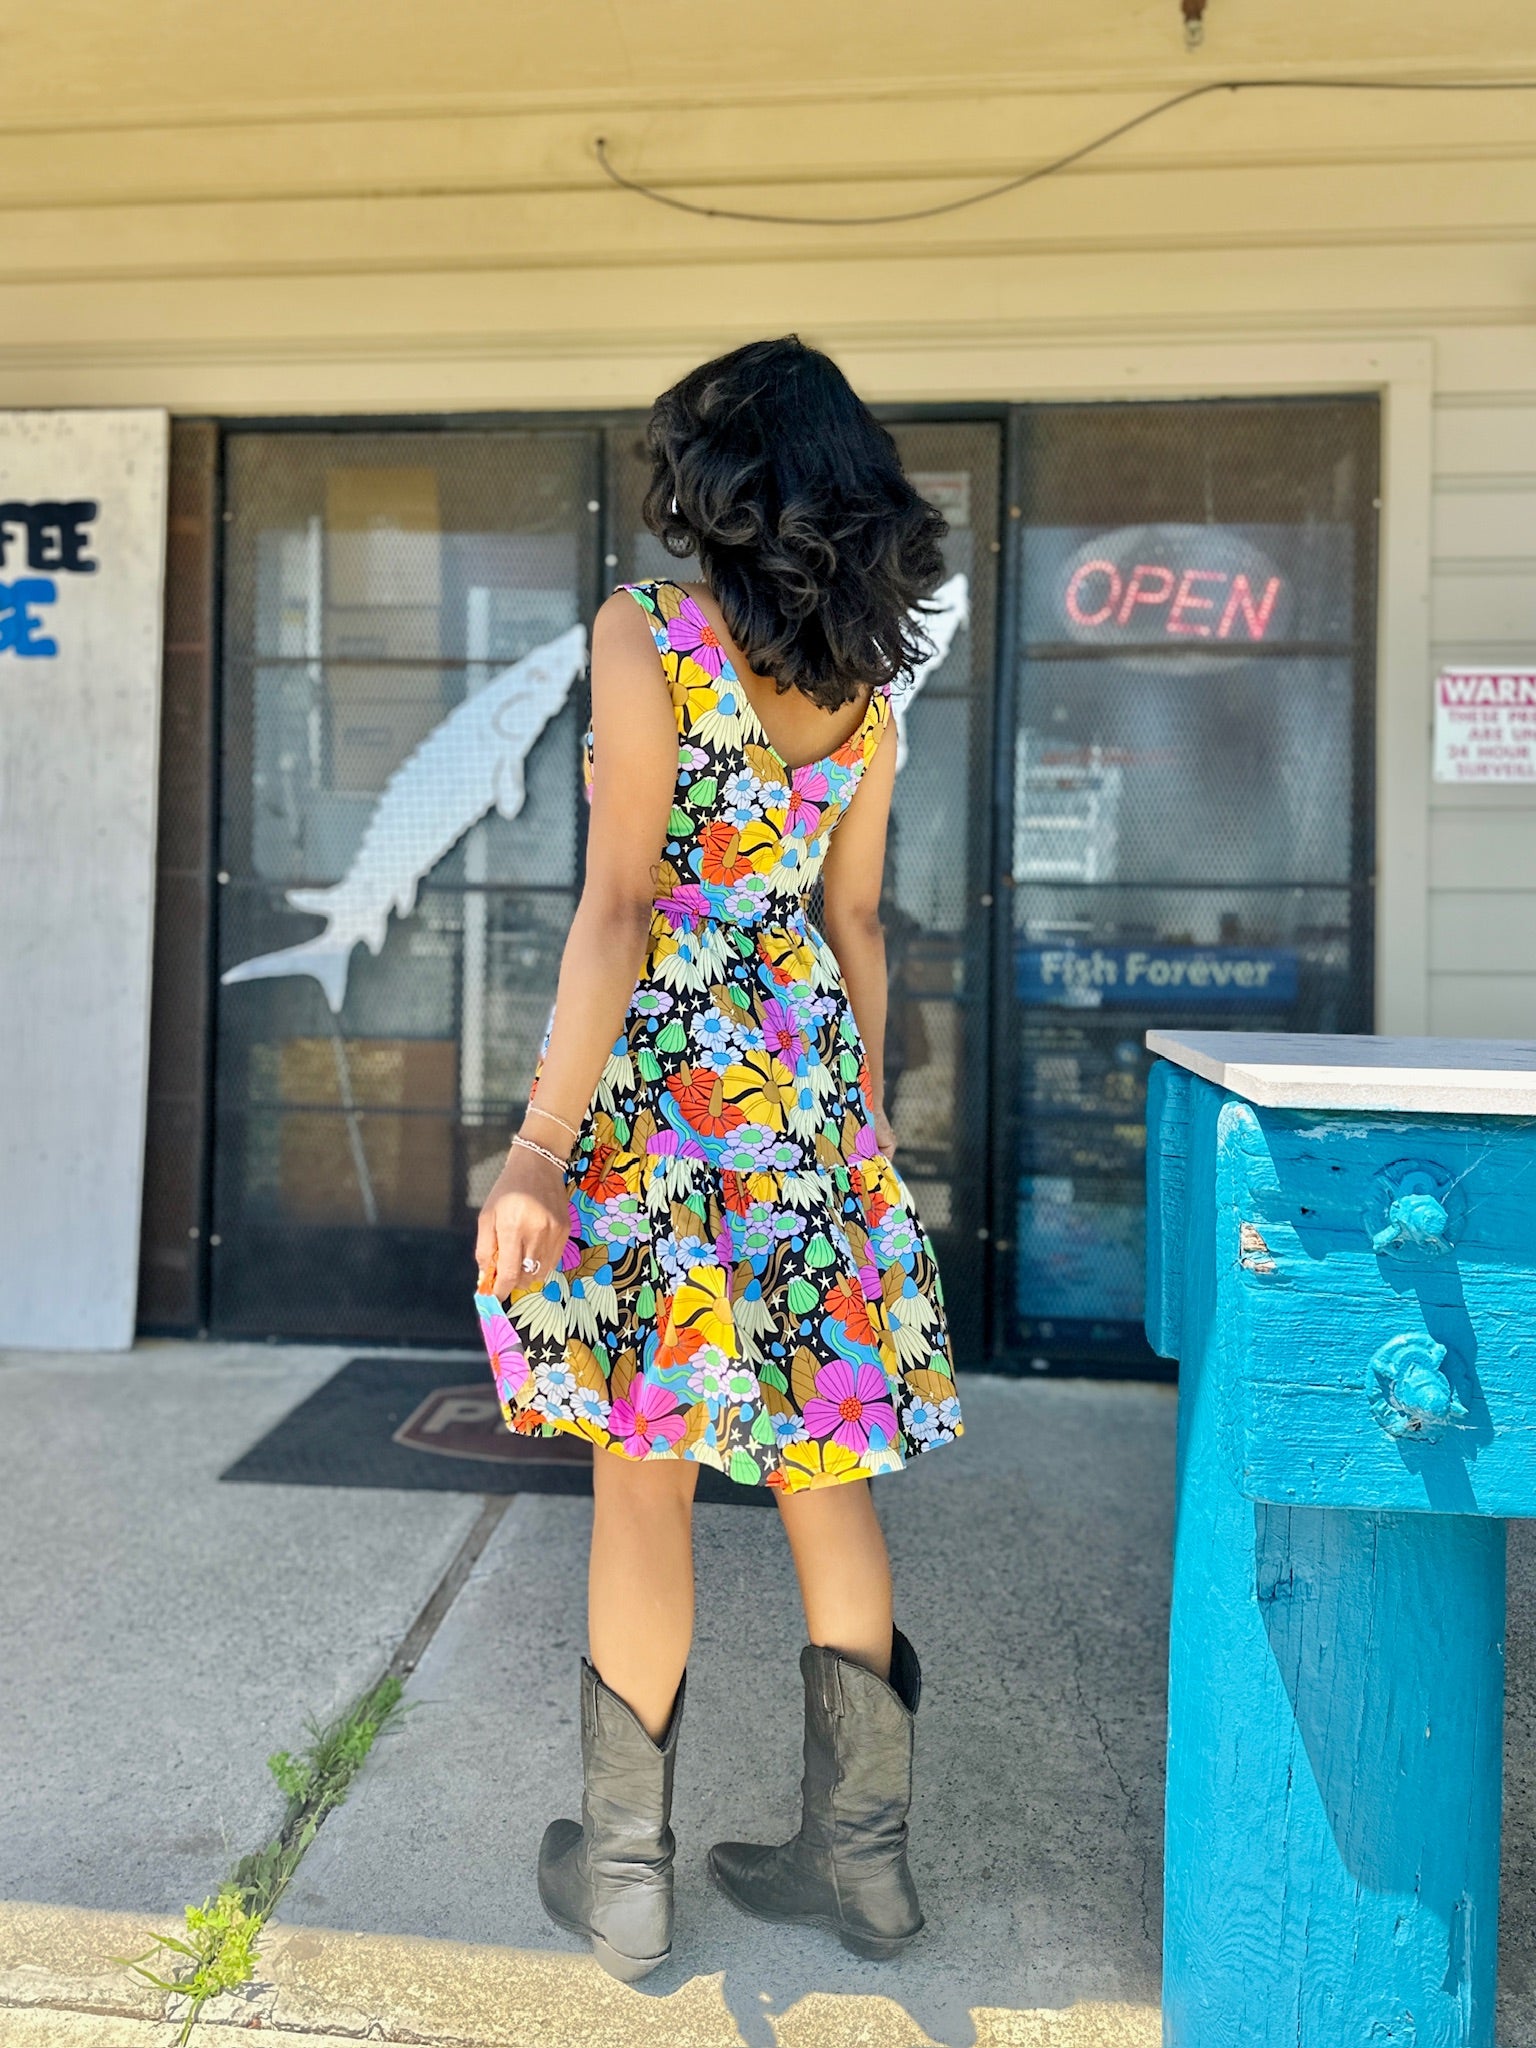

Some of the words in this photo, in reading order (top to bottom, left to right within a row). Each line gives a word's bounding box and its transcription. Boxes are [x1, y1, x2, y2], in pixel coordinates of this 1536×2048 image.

[1065, 560, 1281, 640] OPEN
[1041, 951, 1117, 987] Fish
[1126, 951, 1274, 987] Forever
